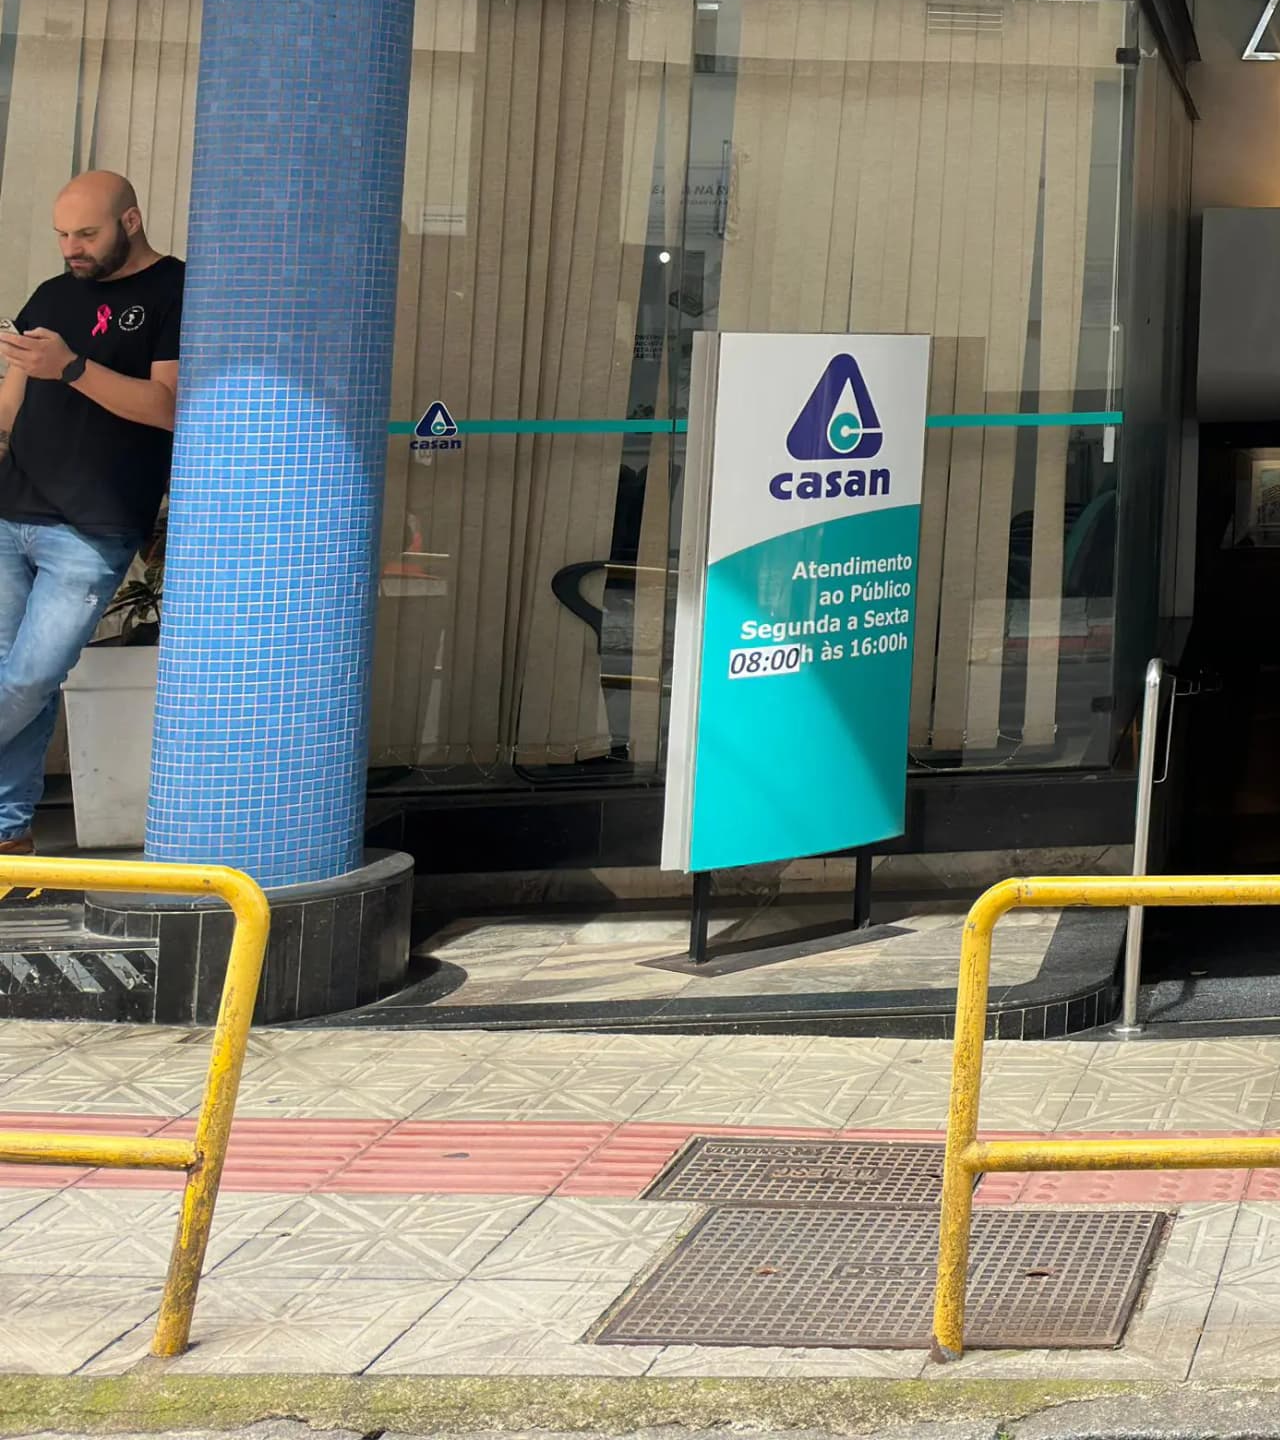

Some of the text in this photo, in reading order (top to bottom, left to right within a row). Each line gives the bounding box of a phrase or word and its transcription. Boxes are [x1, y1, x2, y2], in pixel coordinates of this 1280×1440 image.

[410, 440, 462, 450] casan
[769, 468, 891, 501] casan
[791, 553, 913, 580] Atendimento
[819, 580, 911, 606] ao Público
[740, 607, 909, 642] Segunda a Sexta
[821, 641, 843, 660] às
[850, 632, 908, 657] 16:00h
